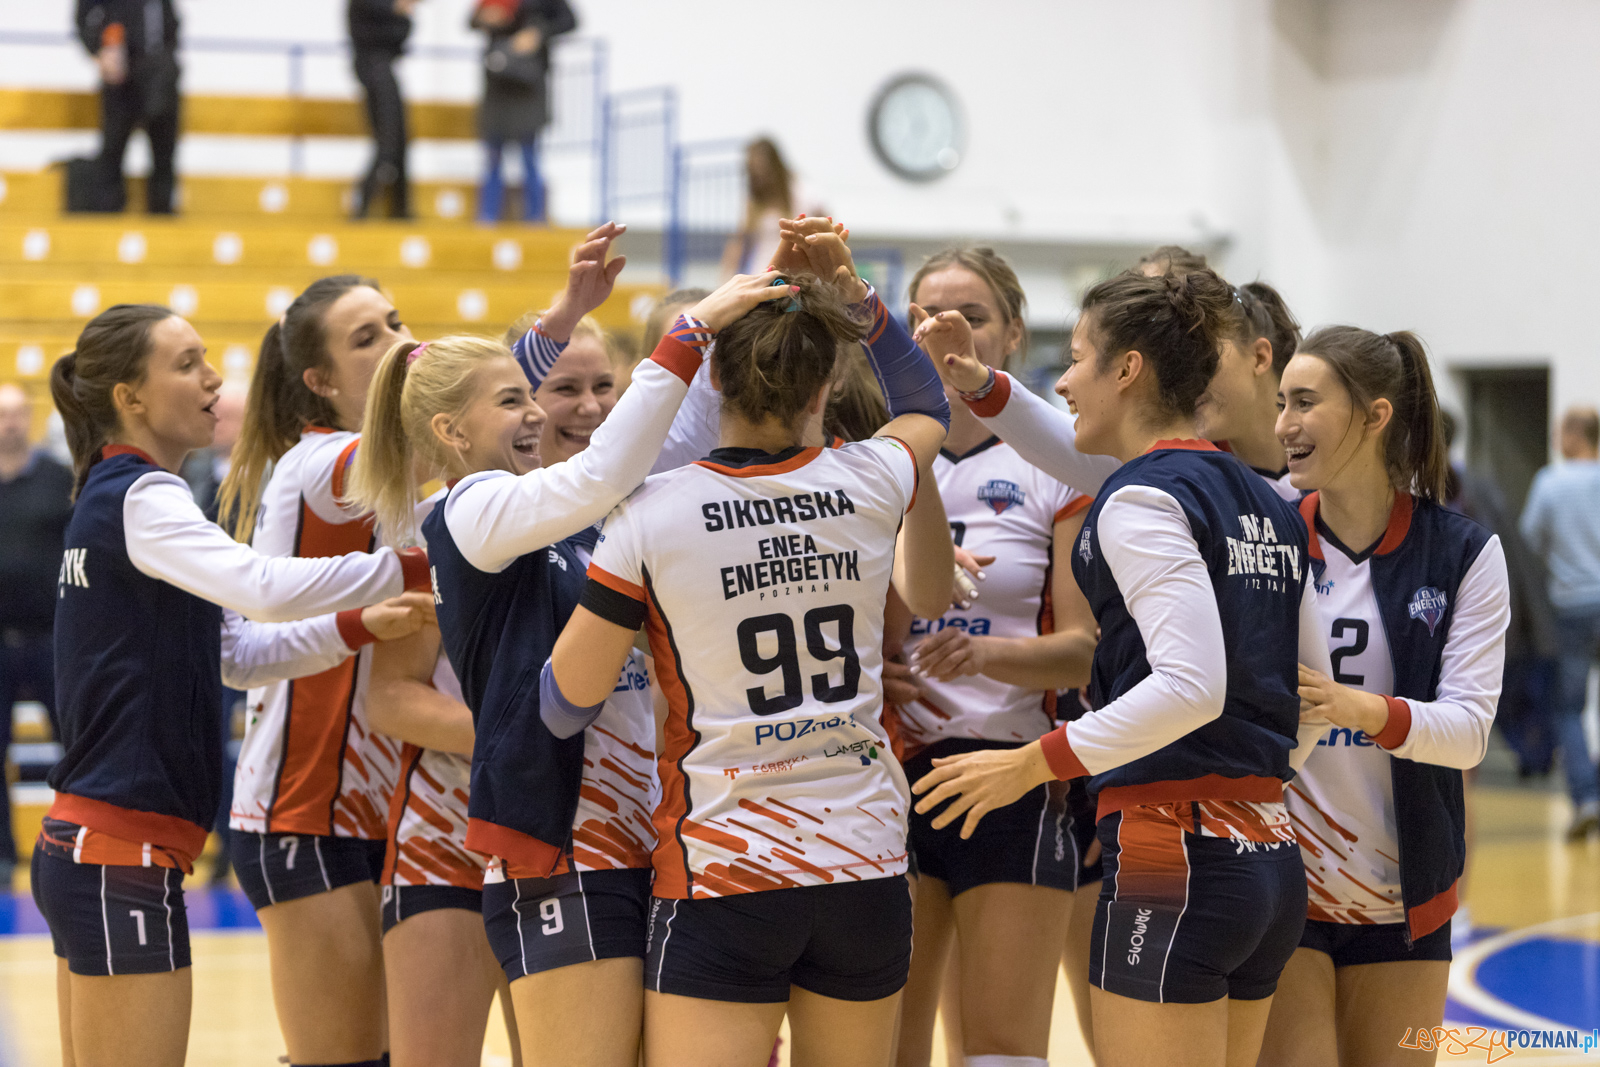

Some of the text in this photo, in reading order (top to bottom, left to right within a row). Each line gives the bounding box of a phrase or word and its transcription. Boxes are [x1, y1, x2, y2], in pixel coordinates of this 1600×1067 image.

[702, 489, 856, 532] SIKORSKA
[758, 534, 818, 560] ENEA
[720, 550, 861, 601] ENERGETYK
[760, 582, 830, 601] POZNAŃ
[737, 603, 862, 716] 99
[1330, 617, 1369, 686] 2
[279, 836, 299, 870] 7
[129, 909, 147, 945] 1
[539, 897, 564, 936] 9
